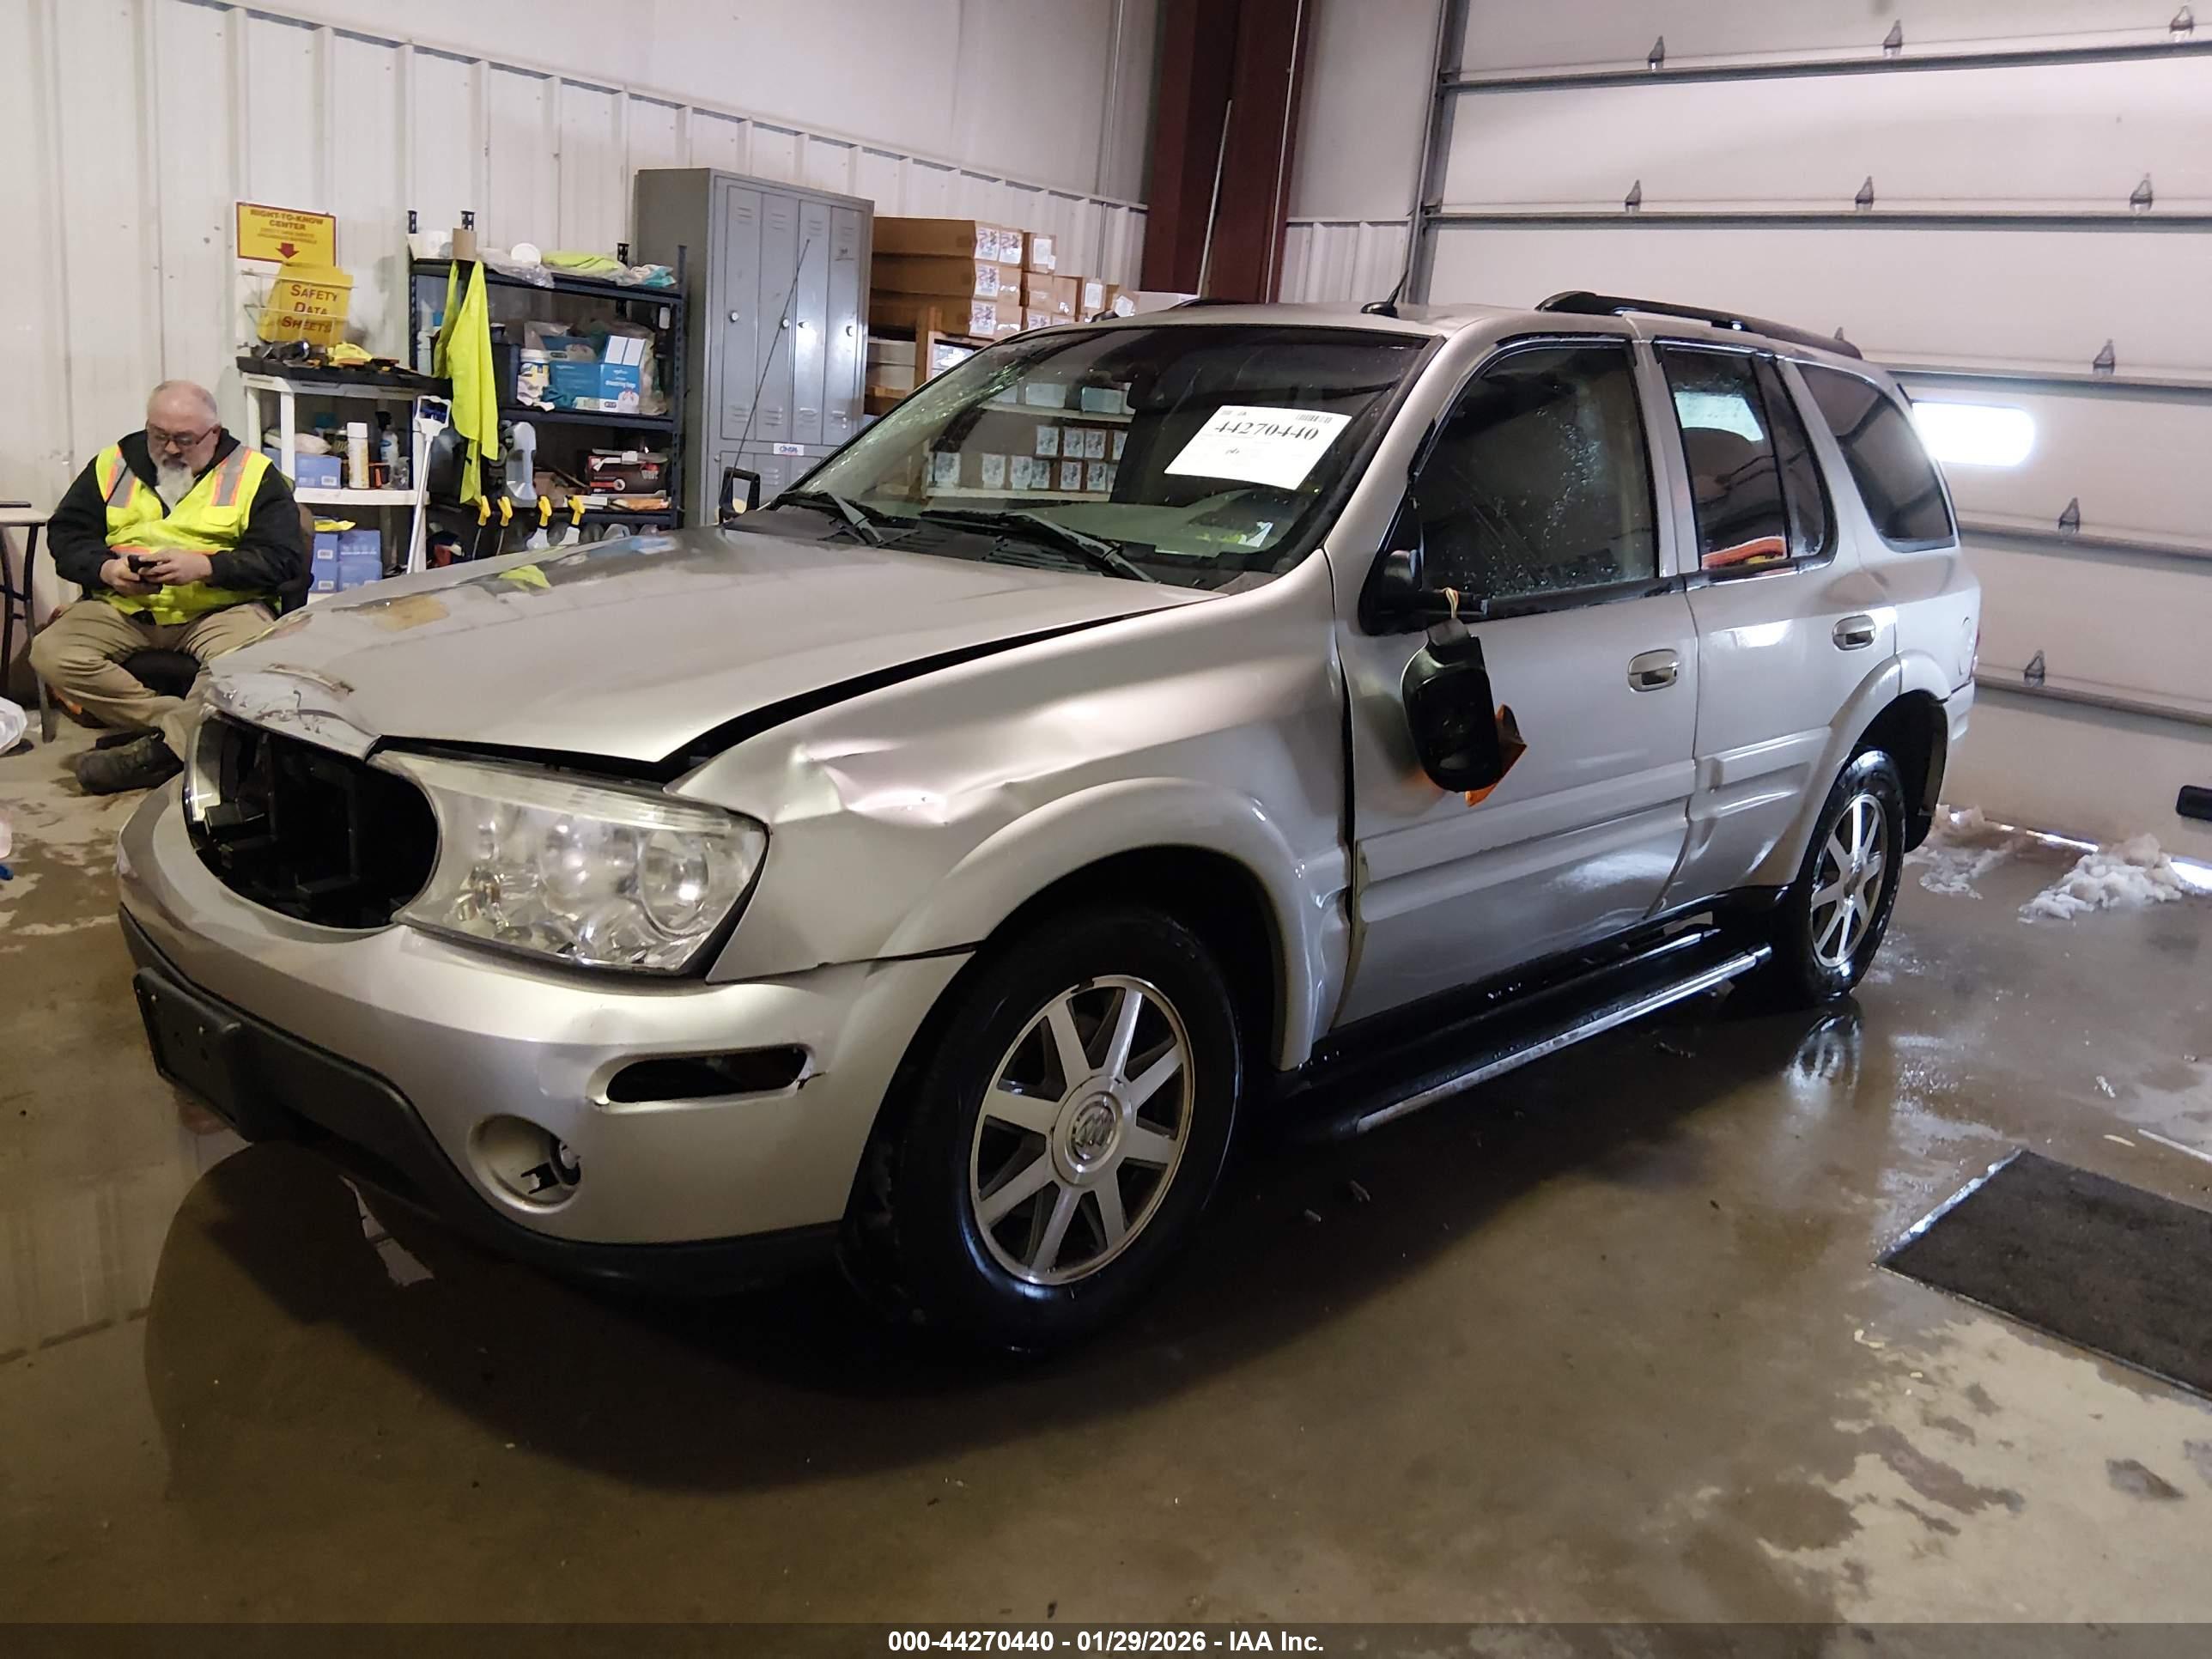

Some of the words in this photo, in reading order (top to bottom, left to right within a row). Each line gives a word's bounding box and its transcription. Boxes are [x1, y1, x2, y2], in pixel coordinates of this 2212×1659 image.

[269, 219, 307, 230] CENTER
[290, 283, 337, 302] SAFETY
[294, 301, 328, 315] DATA
[281, 315, 332, 333] SHEETS
[1214, 421, 1319, 441] 44270440
